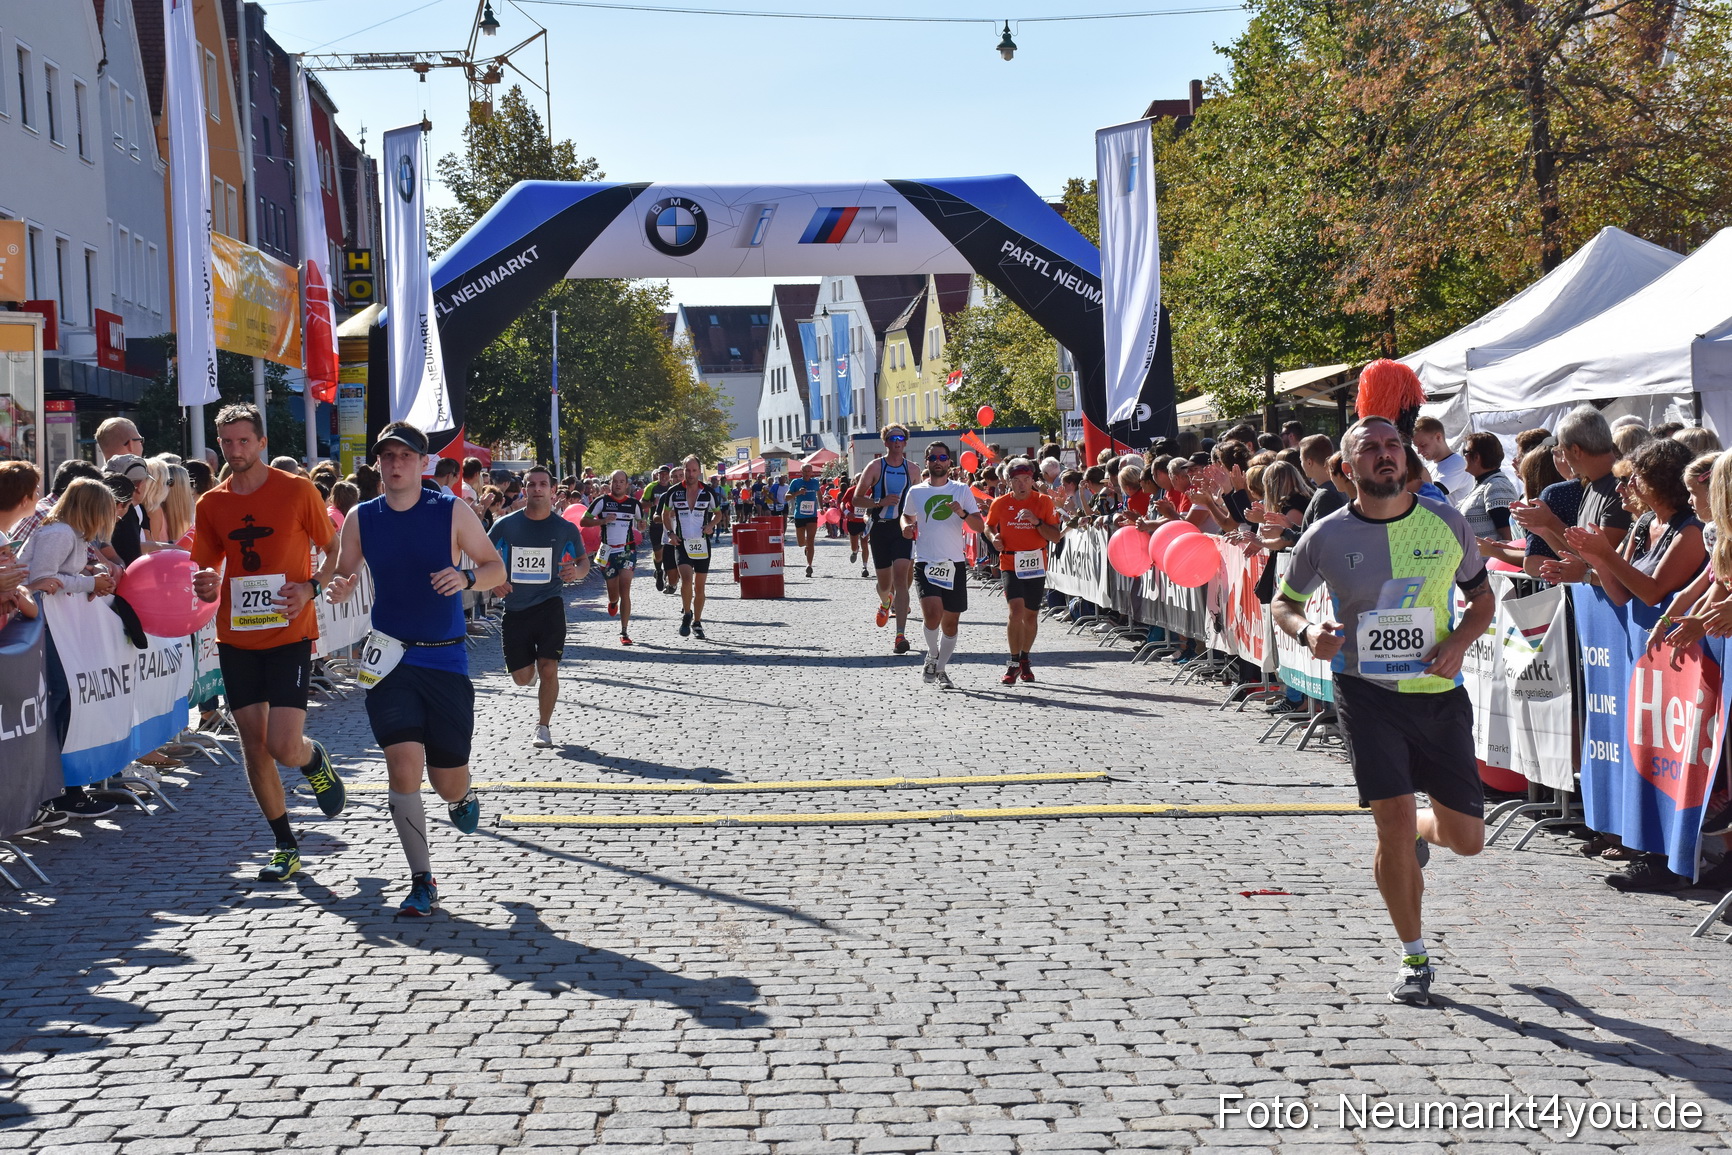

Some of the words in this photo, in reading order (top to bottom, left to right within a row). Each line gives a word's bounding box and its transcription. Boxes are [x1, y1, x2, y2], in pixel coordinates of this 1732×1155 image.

[650, 196, 703, 217] BMW
[1000, 240, 1050, 278] PARTL
[451, 244, 539, 307] NEUMARKT
[109, 321, 127, 351] WITT
[418, 312, 440, 381] NEUMARKT
[688, 543, 702, 552] 342
[517, 556, 546, 569] 3124
[928, 566, 950, 577] 2261
[1019, 557, 1040, 568] 2181
[243, 580, 269, 588] BOCK
[242, 590, 272, 608] 278
[239, 616, 279, 626] Christopher
[1378, 614, 1413, 623] BOCK
[1368, 628, 1424, 651] 2888
[1584, 645, 1610, 668] TORE
[1386, 663, 1410, 672] Erich
[1588, 693, 1617, 716] NLINE
[1589, 739, 1620, 764] OBILE
